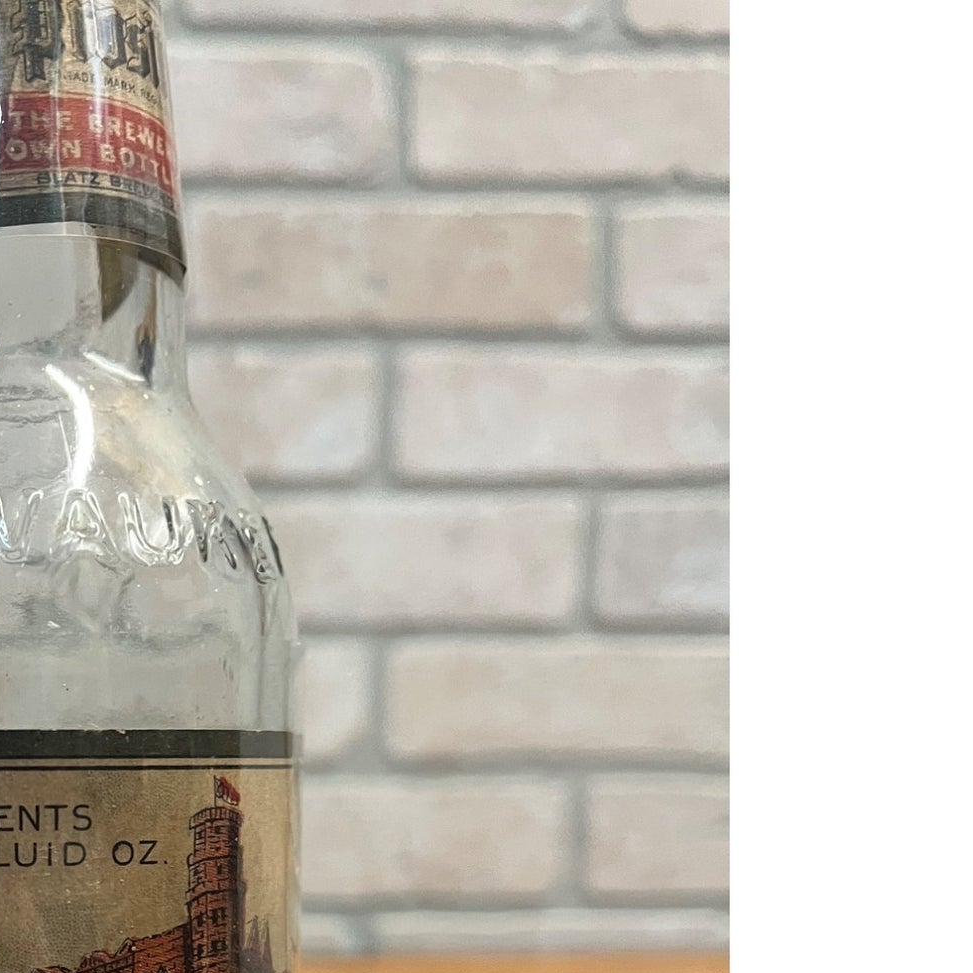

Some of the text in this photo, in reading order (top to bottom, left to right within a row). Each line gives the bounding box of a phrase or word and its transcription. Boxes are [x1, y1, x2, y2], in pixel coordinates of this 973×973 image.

[10, 110, 73, 131] THE
[37, 170, 101, 186] BLATZ
[111, 839, 168, 866] OZ.
